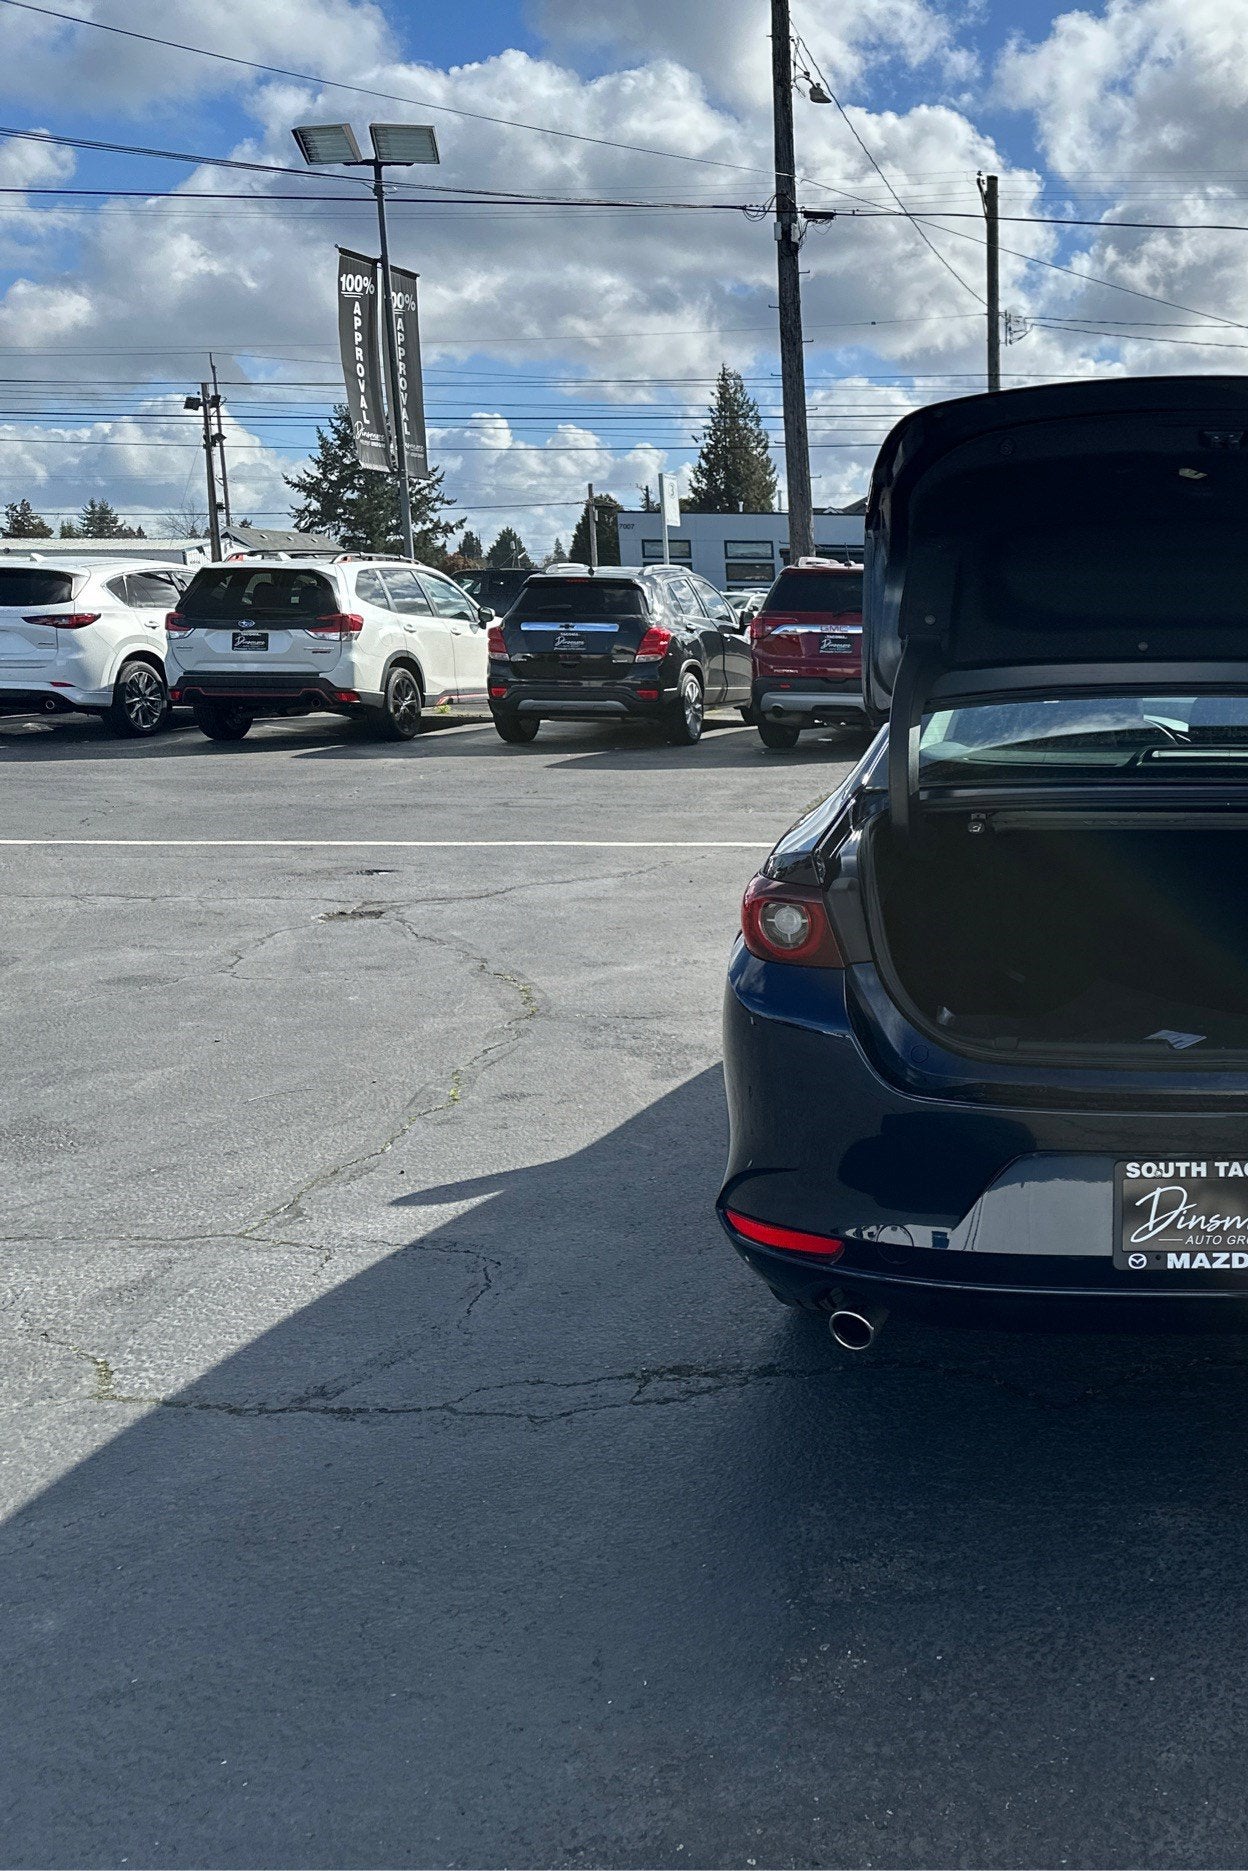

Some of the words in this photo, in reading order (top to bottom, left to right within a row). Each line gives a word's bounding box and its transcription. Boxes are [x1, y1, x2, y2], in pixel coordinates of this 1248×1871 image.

[340, 273, 375, 295] 100%
[391, 292, 416, 312] 00%
[352, 301, 371, 425] APPROVAL
[396, 317, 411, 436] APPROVAL
[820, 625, 849, 633] GMC
[1126, 1161, 1207, 1178] SOUTH
[1185, 1235, 1224, 1245] AUTO
